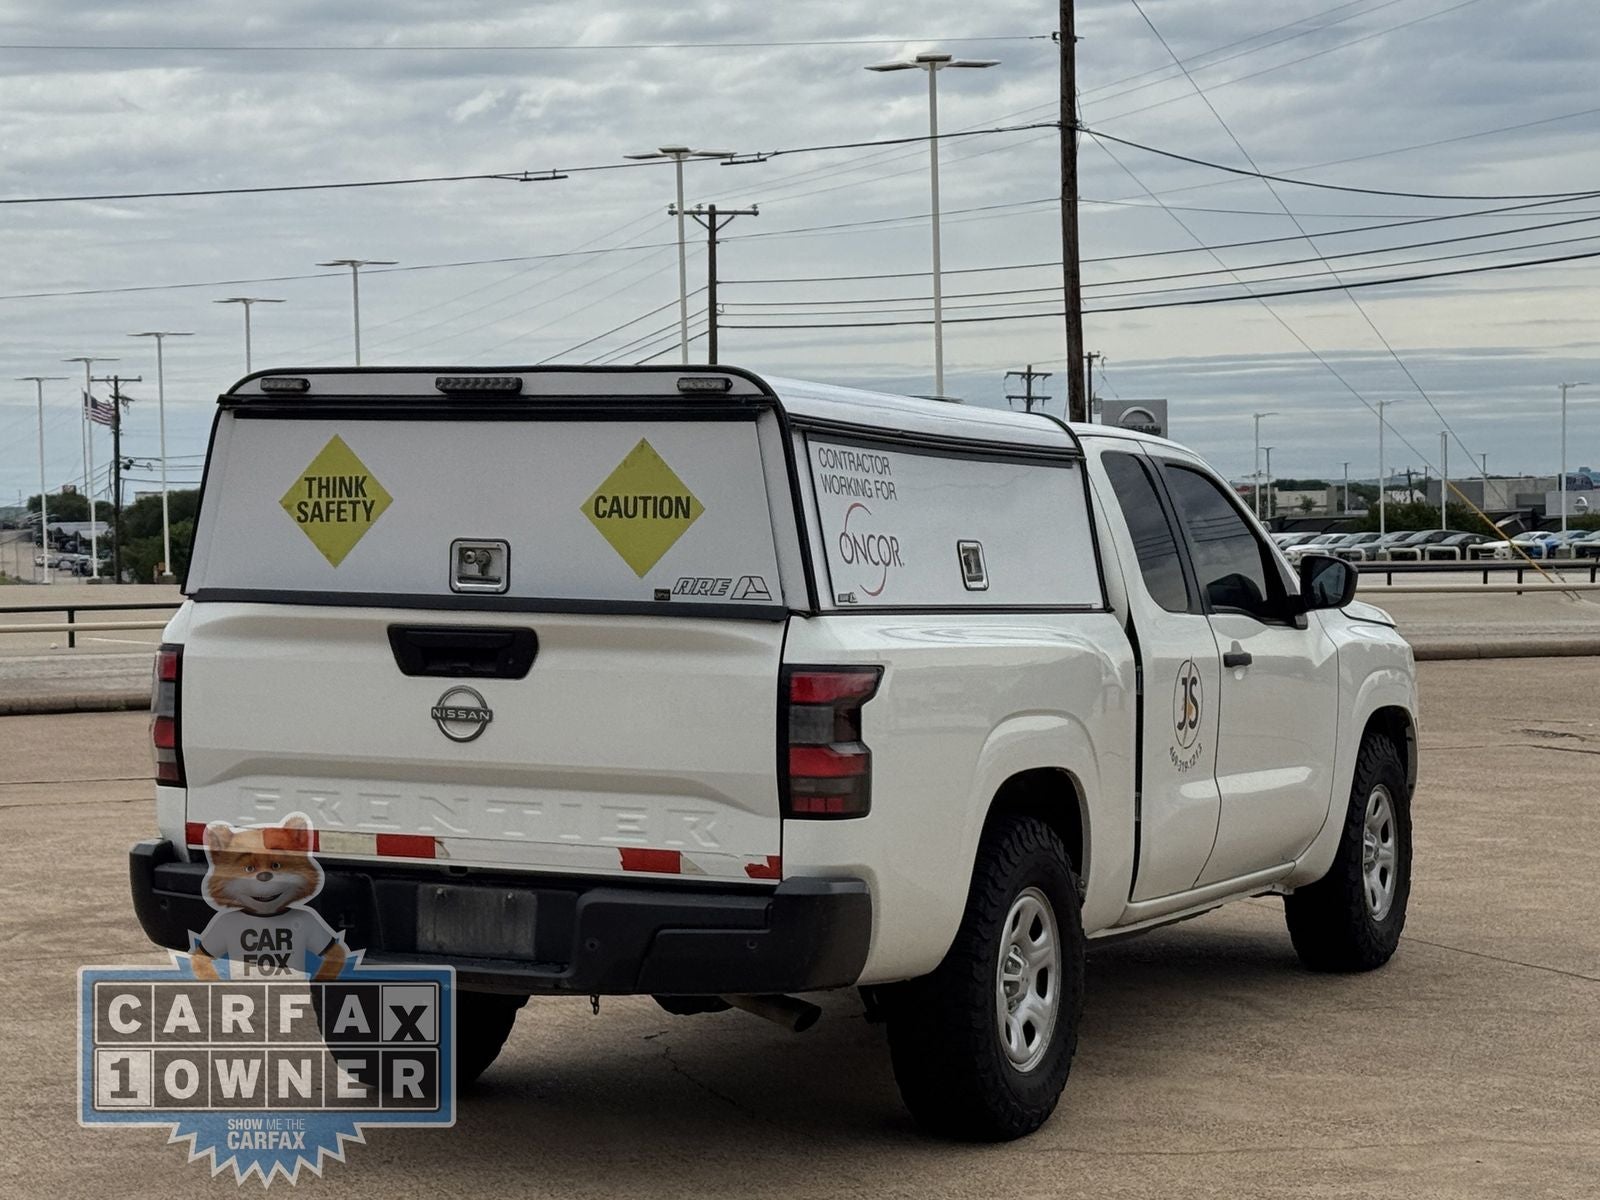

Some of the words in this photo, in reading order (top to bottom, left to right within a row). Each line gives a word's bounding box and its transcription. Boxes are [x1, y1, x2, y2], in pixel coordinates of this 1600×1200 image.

[819, 447, 892, 476] CONTRACTOR
[304, 476, 368, 499] THINK
[820, 474, 873, 499] WORKING
[874, 480, 898, 501] FOR
[296, 499, 376, 523] SAFETY
[594, 495, 691, 520] CAUTION
[432, 708, 490, 721] NISSAN
